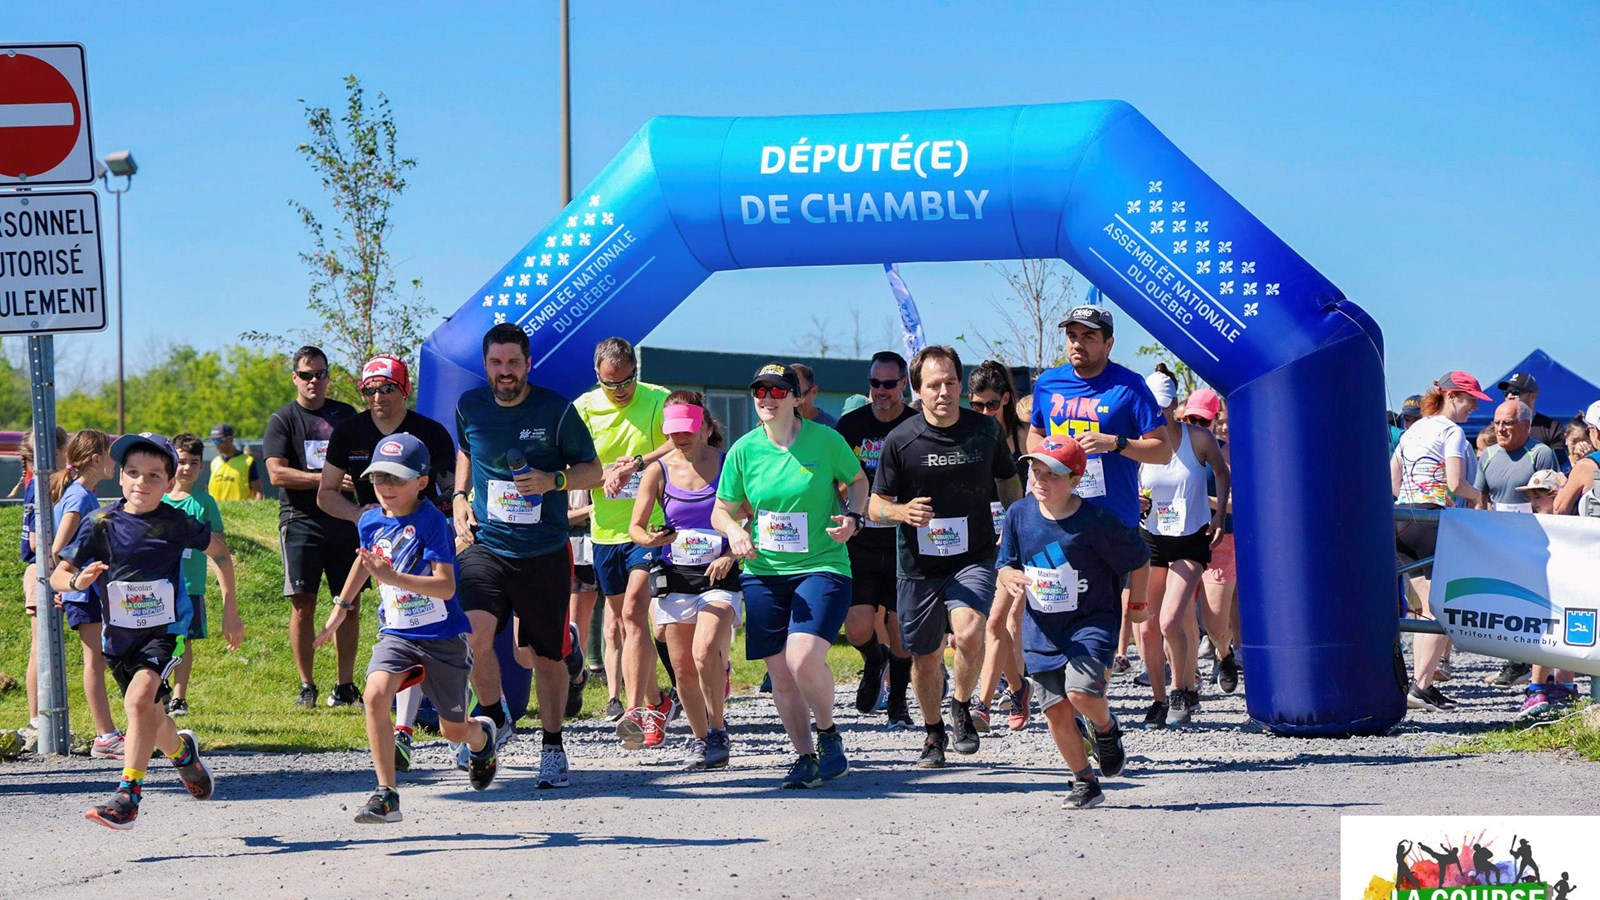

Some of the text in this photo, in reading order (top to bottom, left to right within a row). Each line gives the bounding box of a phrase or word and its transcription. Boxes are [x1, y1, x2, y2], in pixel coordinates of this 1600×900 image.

[760, 134, 969, 178] DÉPUTÉ(E)
[0, 209, 93, 237] SONNEL
[740, 189, 990, 225] DE CHAMBLY
[522, 230, 637, 337] SEMBLÉE NATIONALE
[1103, 222, 1241, 343] ASSEMBLÉE NATIONALE
[1126, 264, 1194, 325] DU QUÉBEC
[552, 274, 617, 333] DU QUÉBEC
[127, 584, 153, 592] Nicolas
[136, 619, 147, 627] 59
[409, 618, 420, 626] 58
[1443, 607, 1560, 634] TRIFORT
[1460, 629, 1492, 640] Trifort
[1513, 635, 1557, 647] Chambly
